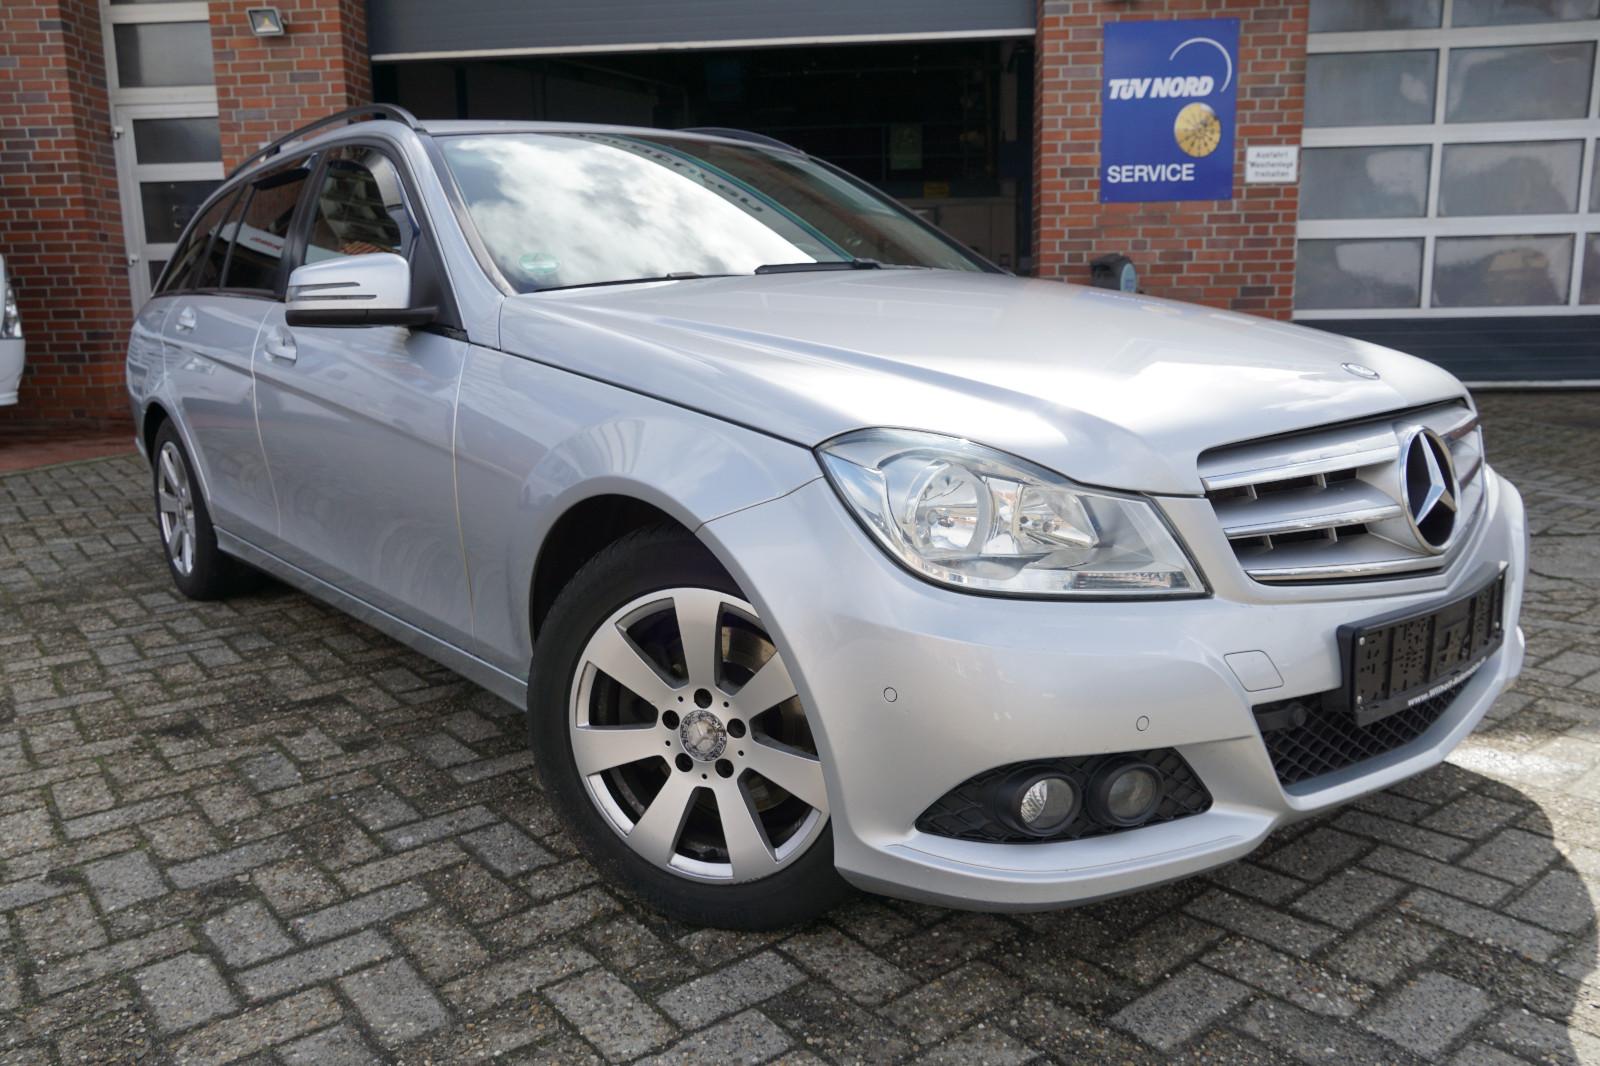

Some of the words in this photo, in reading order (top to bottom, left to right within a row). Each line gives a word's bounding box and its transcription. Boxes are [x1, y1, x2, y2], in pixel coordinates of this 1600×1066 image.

[1109, 78, 1151, 100] TÜV
[1150, 76, 1214, 98] NORD
[1107, 163, 1195, 183] SERVICE
